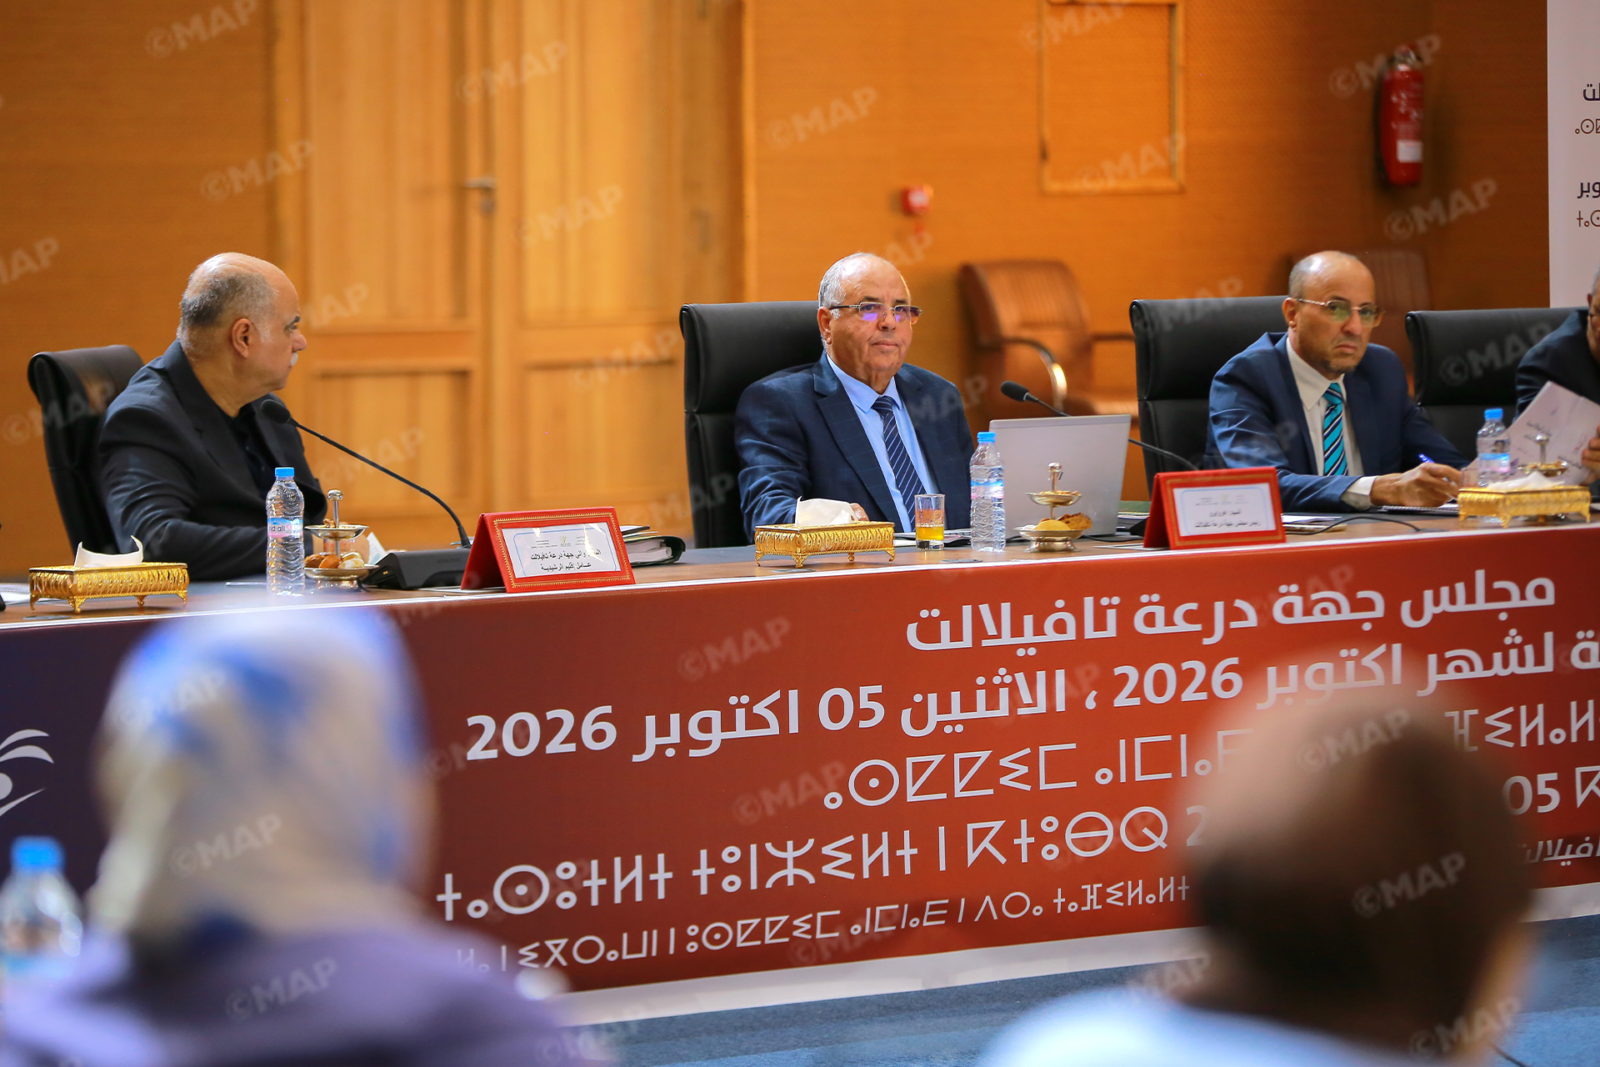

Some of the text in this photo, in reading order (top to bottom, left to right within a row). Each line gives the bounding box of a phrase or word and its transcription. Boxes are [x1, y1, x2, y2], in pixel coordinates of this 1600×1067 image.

[905, 568, 1555, 657] مجلس جهة درعة تافيلالت
[1113, 656, 1244, 708] 2026
[1256, 643, 1402, 711] اكتوبر
[1416, 628, 1554, 697] لشهر
[466, 704, 618, 761] 2026
[631, 689, 800, 763] اكتوبر
[817, 684, 886, 732] 05
[900, 667, 1067, 737] الاثنين
[1502, 772, 1561, 816] 05
